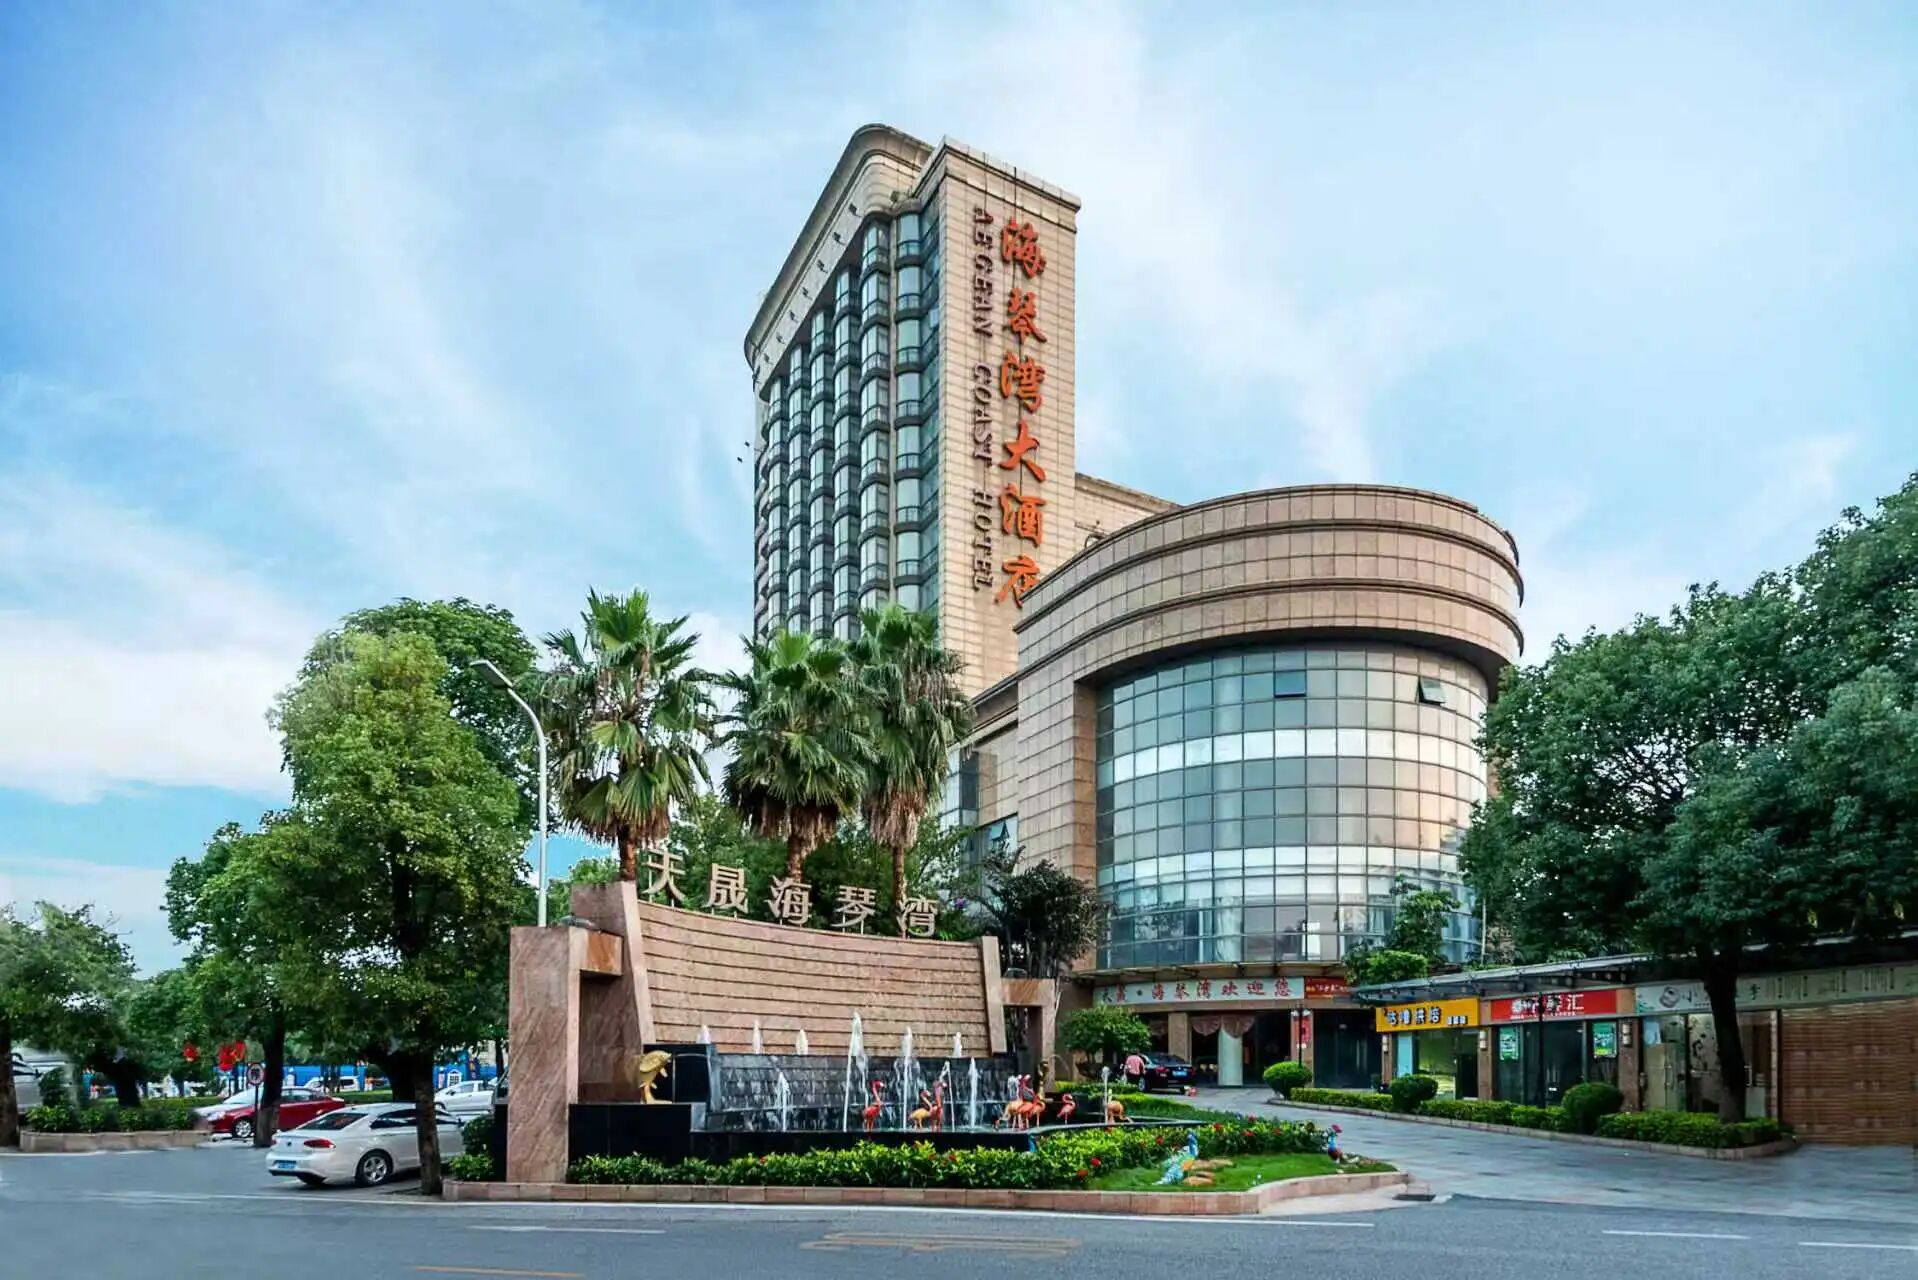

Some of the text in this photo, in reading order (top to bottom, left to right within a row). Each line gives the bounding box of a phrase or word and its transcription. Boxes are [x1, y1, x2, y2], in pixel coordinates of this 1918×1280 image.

[973, 205, 994, 592] AEGEAN COAST HOTEL
[641, 847, 938, 937] 天晟海琴湾
